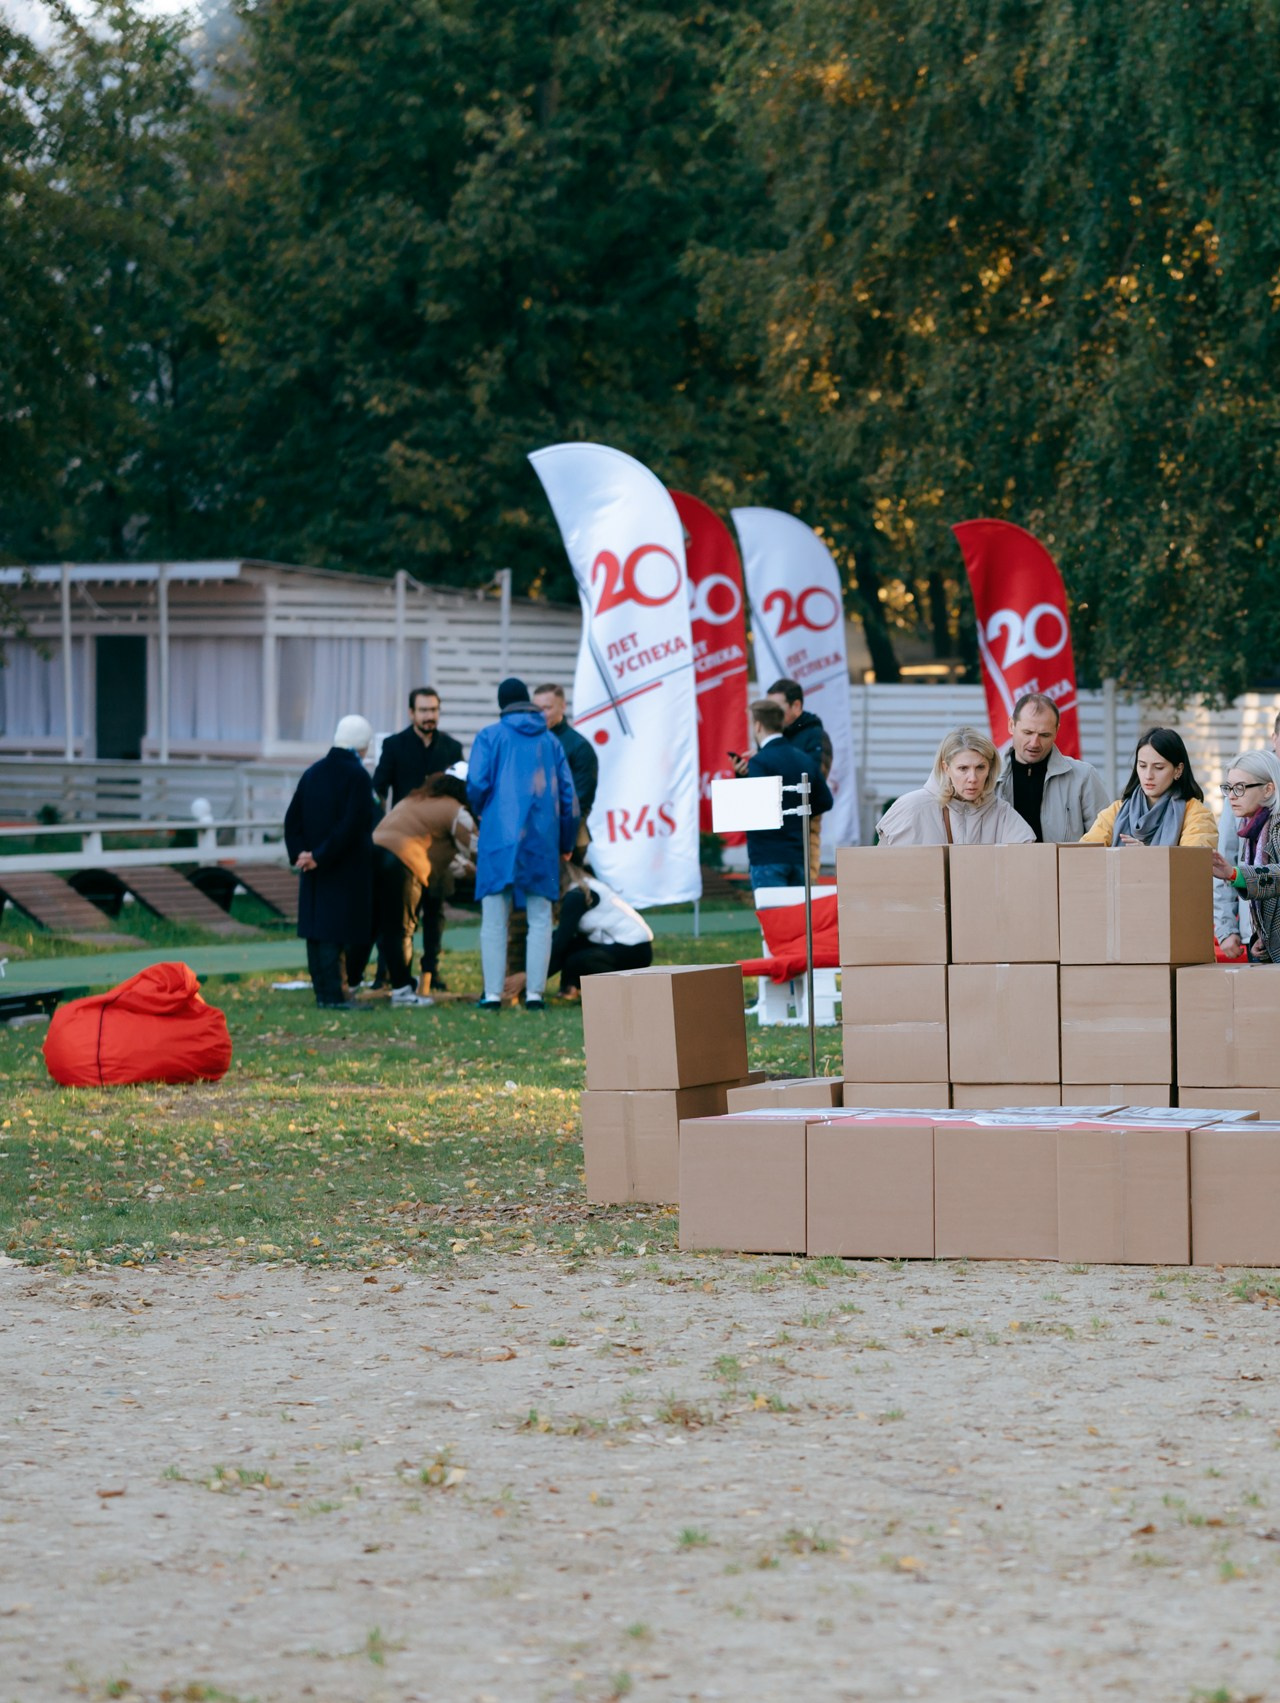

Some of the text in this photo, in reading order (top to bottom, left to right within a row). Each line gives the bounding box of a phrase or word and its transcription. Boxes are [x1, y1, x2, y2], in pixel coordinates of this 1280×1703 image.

[591, 543, 681, 616] 20
[763, 586, 839, 637] 20
[607, 632, 638, 660] ЛЕТ
[613, 636, 687, 678] УСПЕХА
[695, 645, 743, 672] СПЕХА
[986, 603, 1068, 671] 20
[607, 801, 677, 844] R4S
